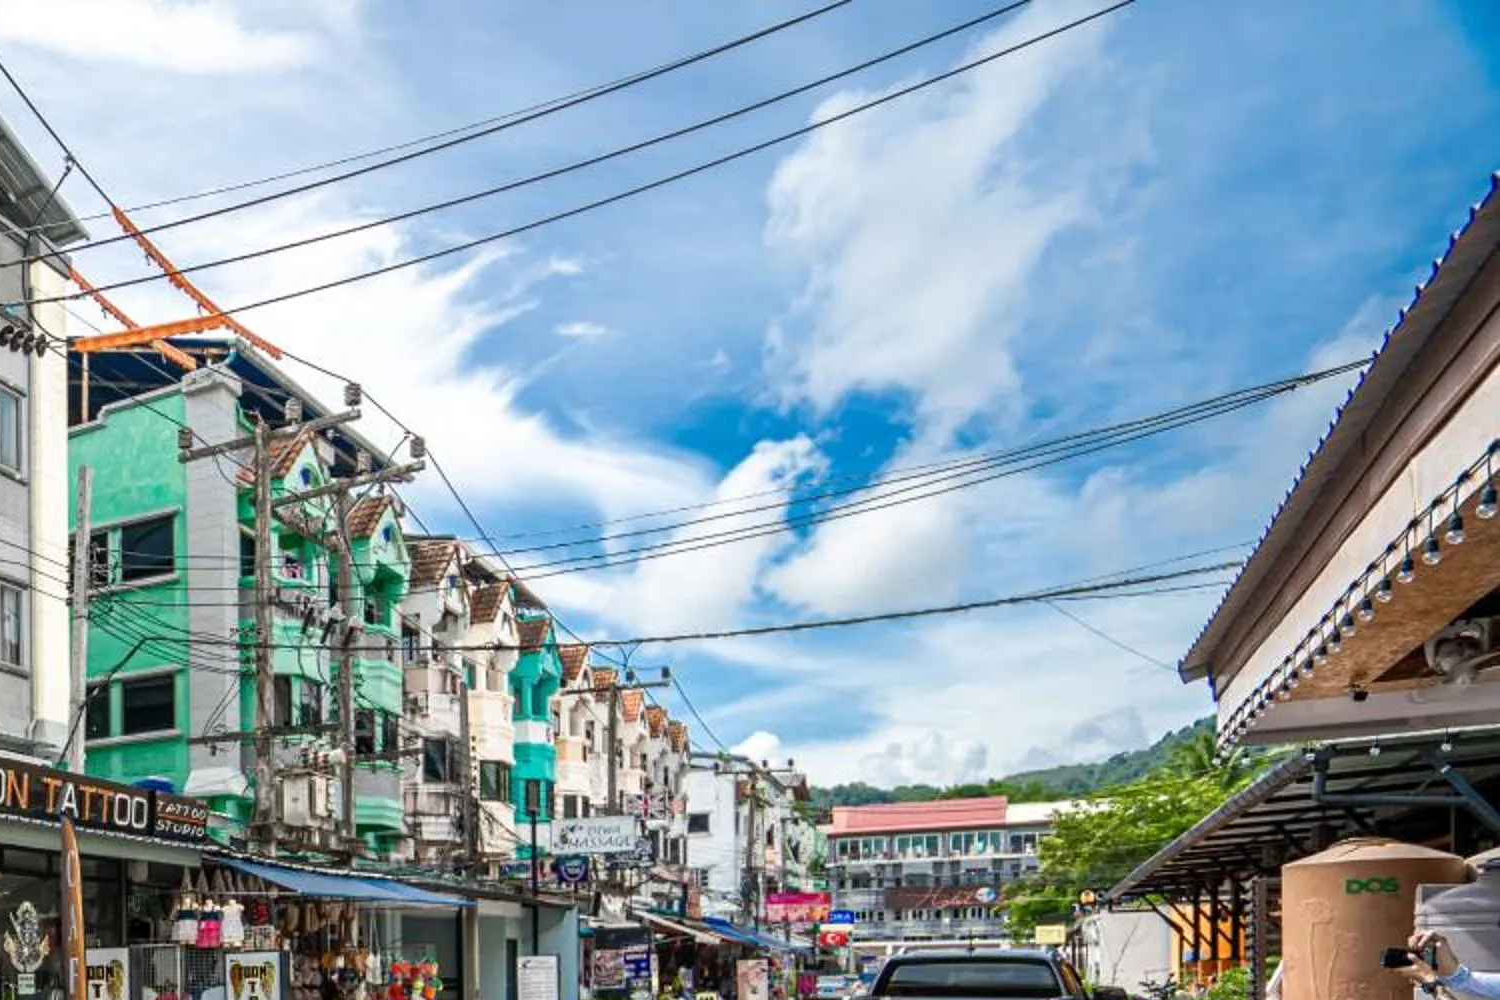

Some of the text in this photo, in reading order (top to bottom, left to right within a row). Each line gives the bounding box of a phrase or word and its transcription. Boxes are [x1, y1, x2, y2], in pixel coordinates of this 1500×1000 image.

[42, 777, 149, 829] TATTOO
[156, 801, 206, 819] TATTOO
[156, 820, 205, 837] STUDIO
[1346, 877, 1399, 895] DOS
